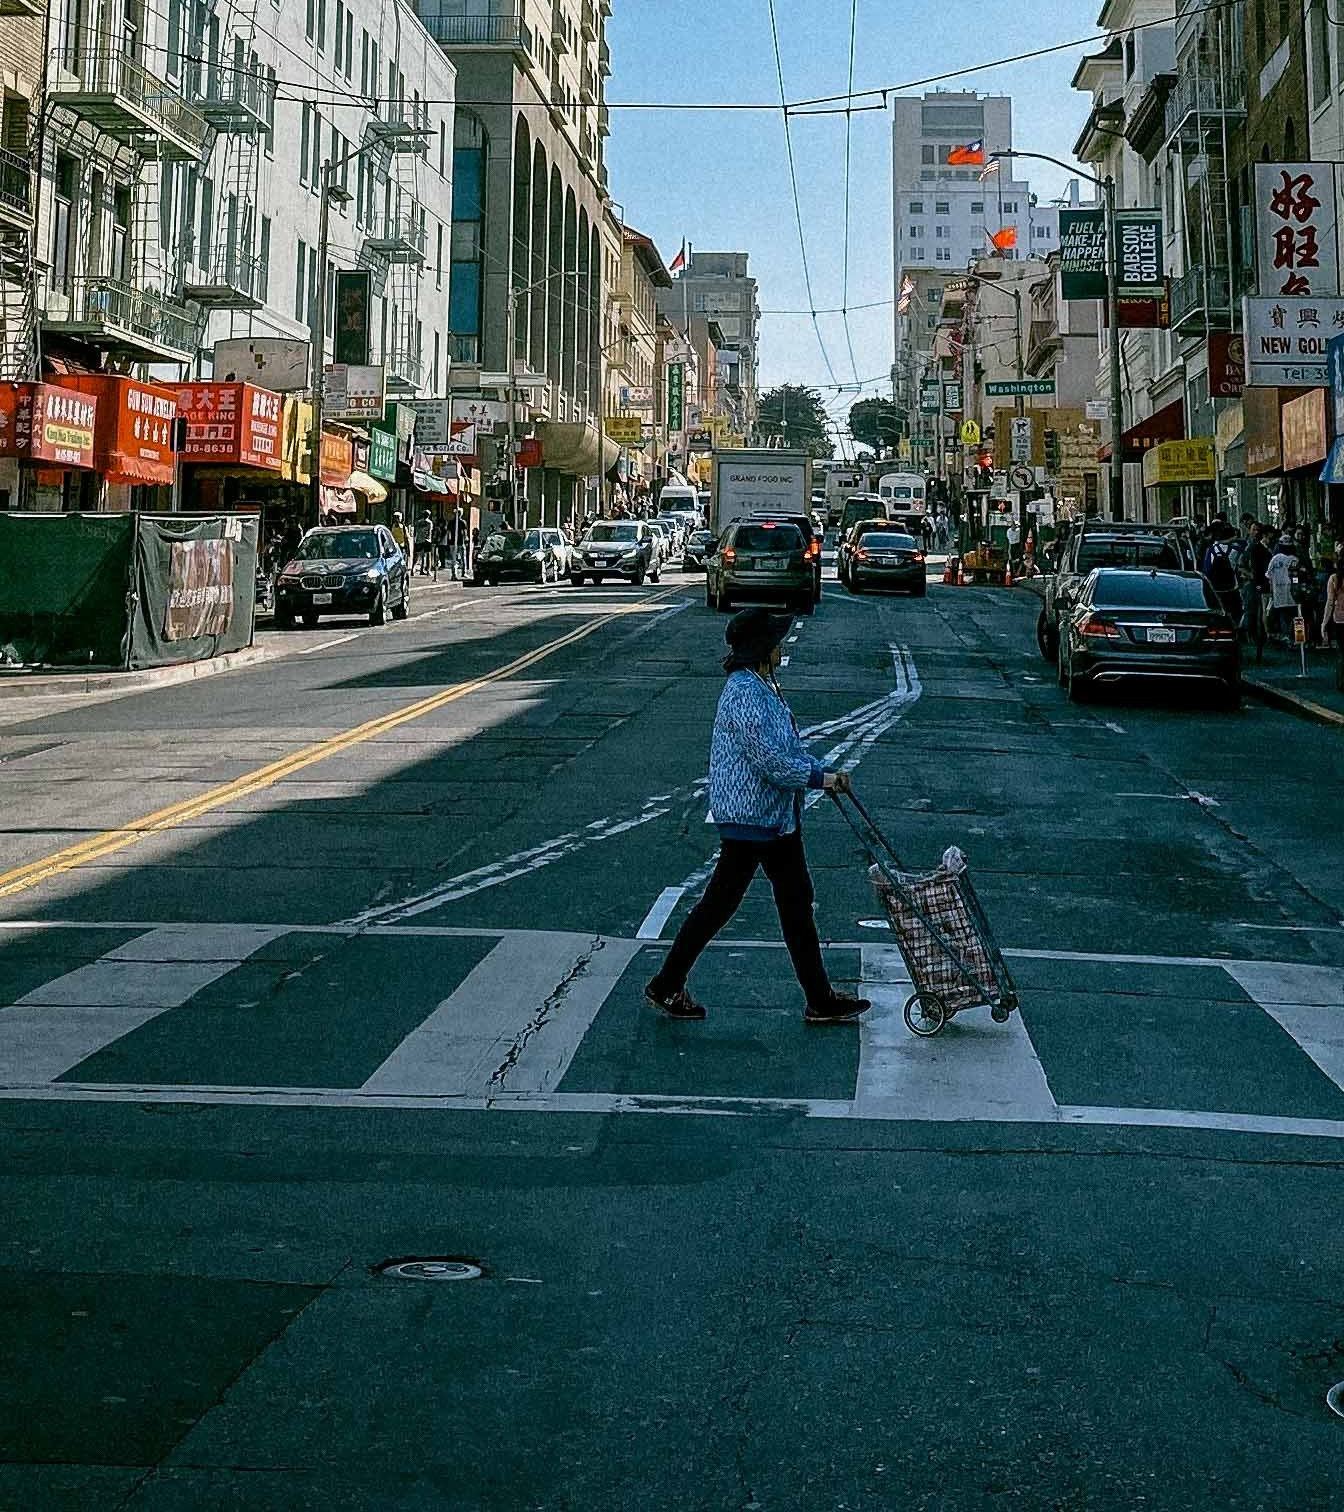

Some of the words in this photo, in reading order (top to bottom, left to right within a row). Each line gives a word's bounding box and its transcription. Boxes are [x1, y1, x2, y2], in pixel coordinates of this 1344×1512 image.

[1069, 222, 1095, 234] FUEL
[1060, 234, 1105, 247] MAKE-IT-
[1122, 225, 1140, 282] BABSON
[1140, 225, 1157, 282] COLLEGE
[1260, 336, 1291, 354] NEW
[988, 383, 1052, 394] Washington
[208, 411, 235, 421] KING
